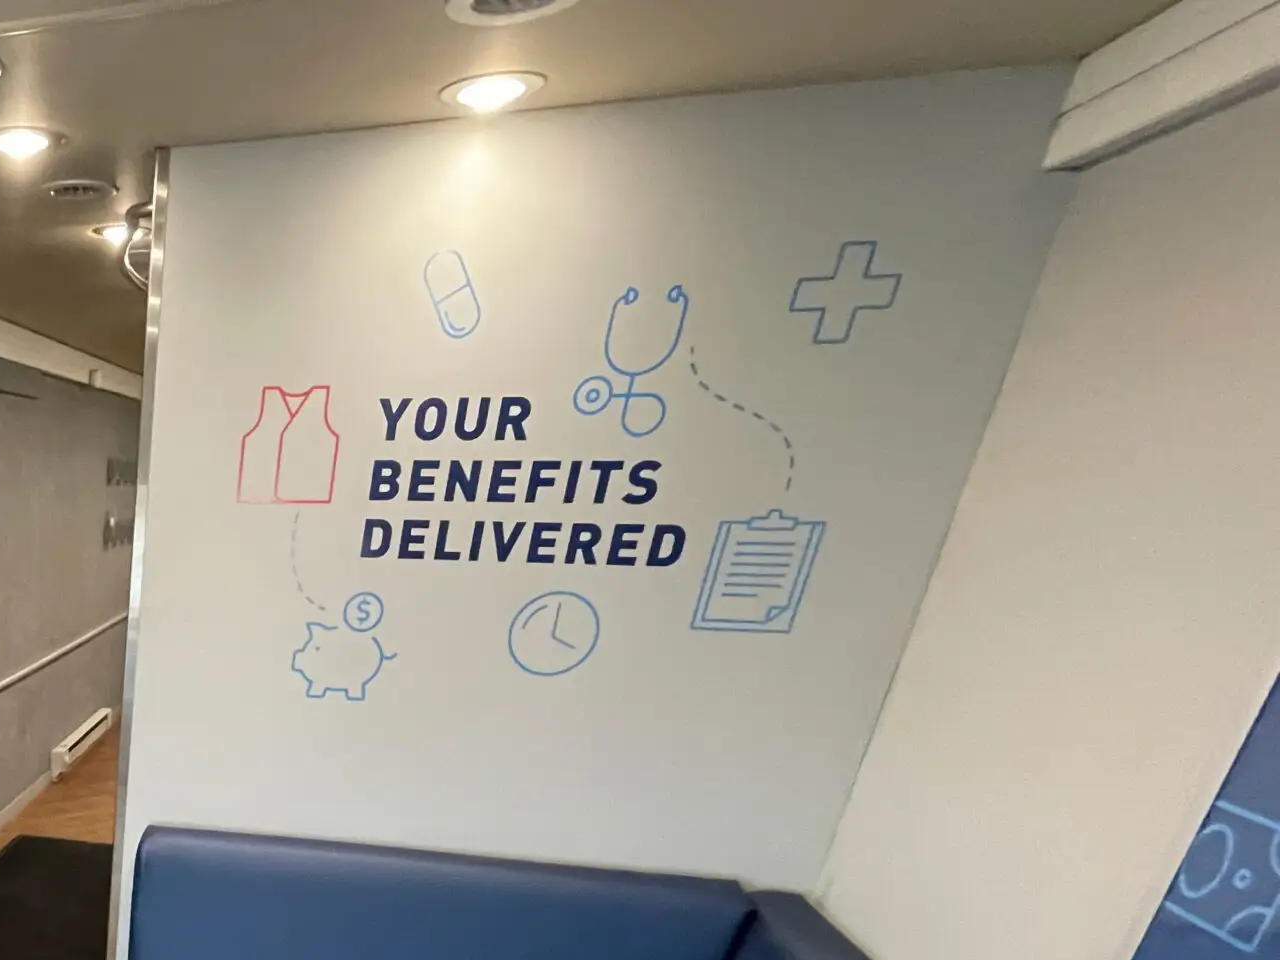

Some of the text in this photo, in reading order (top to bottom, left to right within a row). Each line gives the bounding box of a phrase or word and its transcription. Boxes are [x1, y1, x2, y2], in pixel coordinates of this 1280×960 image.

[379, 397, 532, 441] YOUR
[368, 459, 663, 505] BENEFITS
[360, 518, 687, 567] DELIVERED
